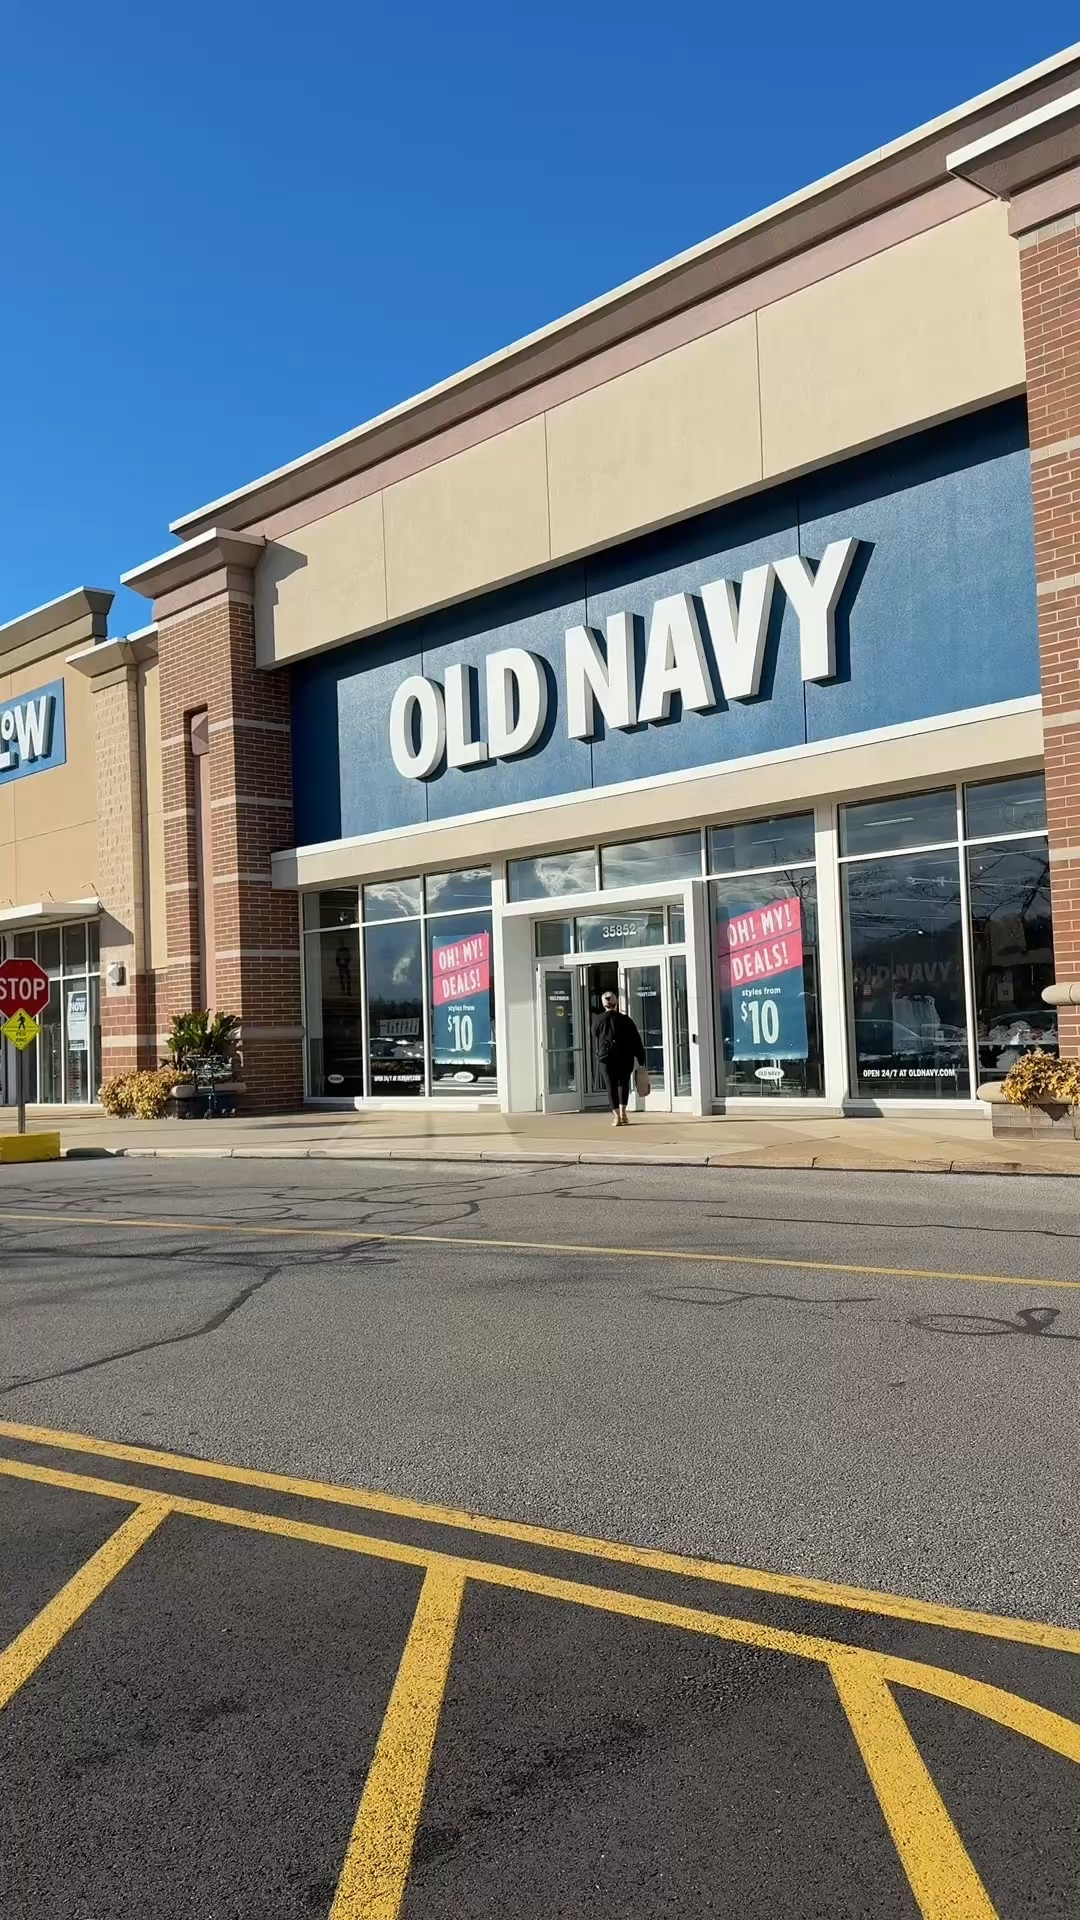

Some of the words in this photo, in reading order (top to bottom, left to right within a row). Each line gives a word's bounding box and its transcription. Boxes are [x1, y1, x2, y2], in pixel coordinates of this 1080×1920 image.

[389, 647, 548, 779] OLD
[565, 537, 858, 740] NAVY
[602, 923, 637, 938] 35852
[728, 917, 756, 947] OH!
[761, 904, 793, 936] MY!
[438, 946, 460, 970] OH!
[463, 938, 484, 962] MY!
[732, 942, 789, 981] DEALS!
[0, 977, 46, 1000] STOP
[441, 968, 481, 999] DEALS!
[741, 987, 762, 996] styles
[763, 987, 781, 995] from
[447, 1015, 473, 1052] $10
[741, 1000, 780, 1044] $10
[863, 1069, 880, 1078] OPEN
[882, 1069, 898, 1078] 24/7
[899, 1069, 907, 1077] AT
[908, 1068, 956, 1077] OLDNAVY.COM
